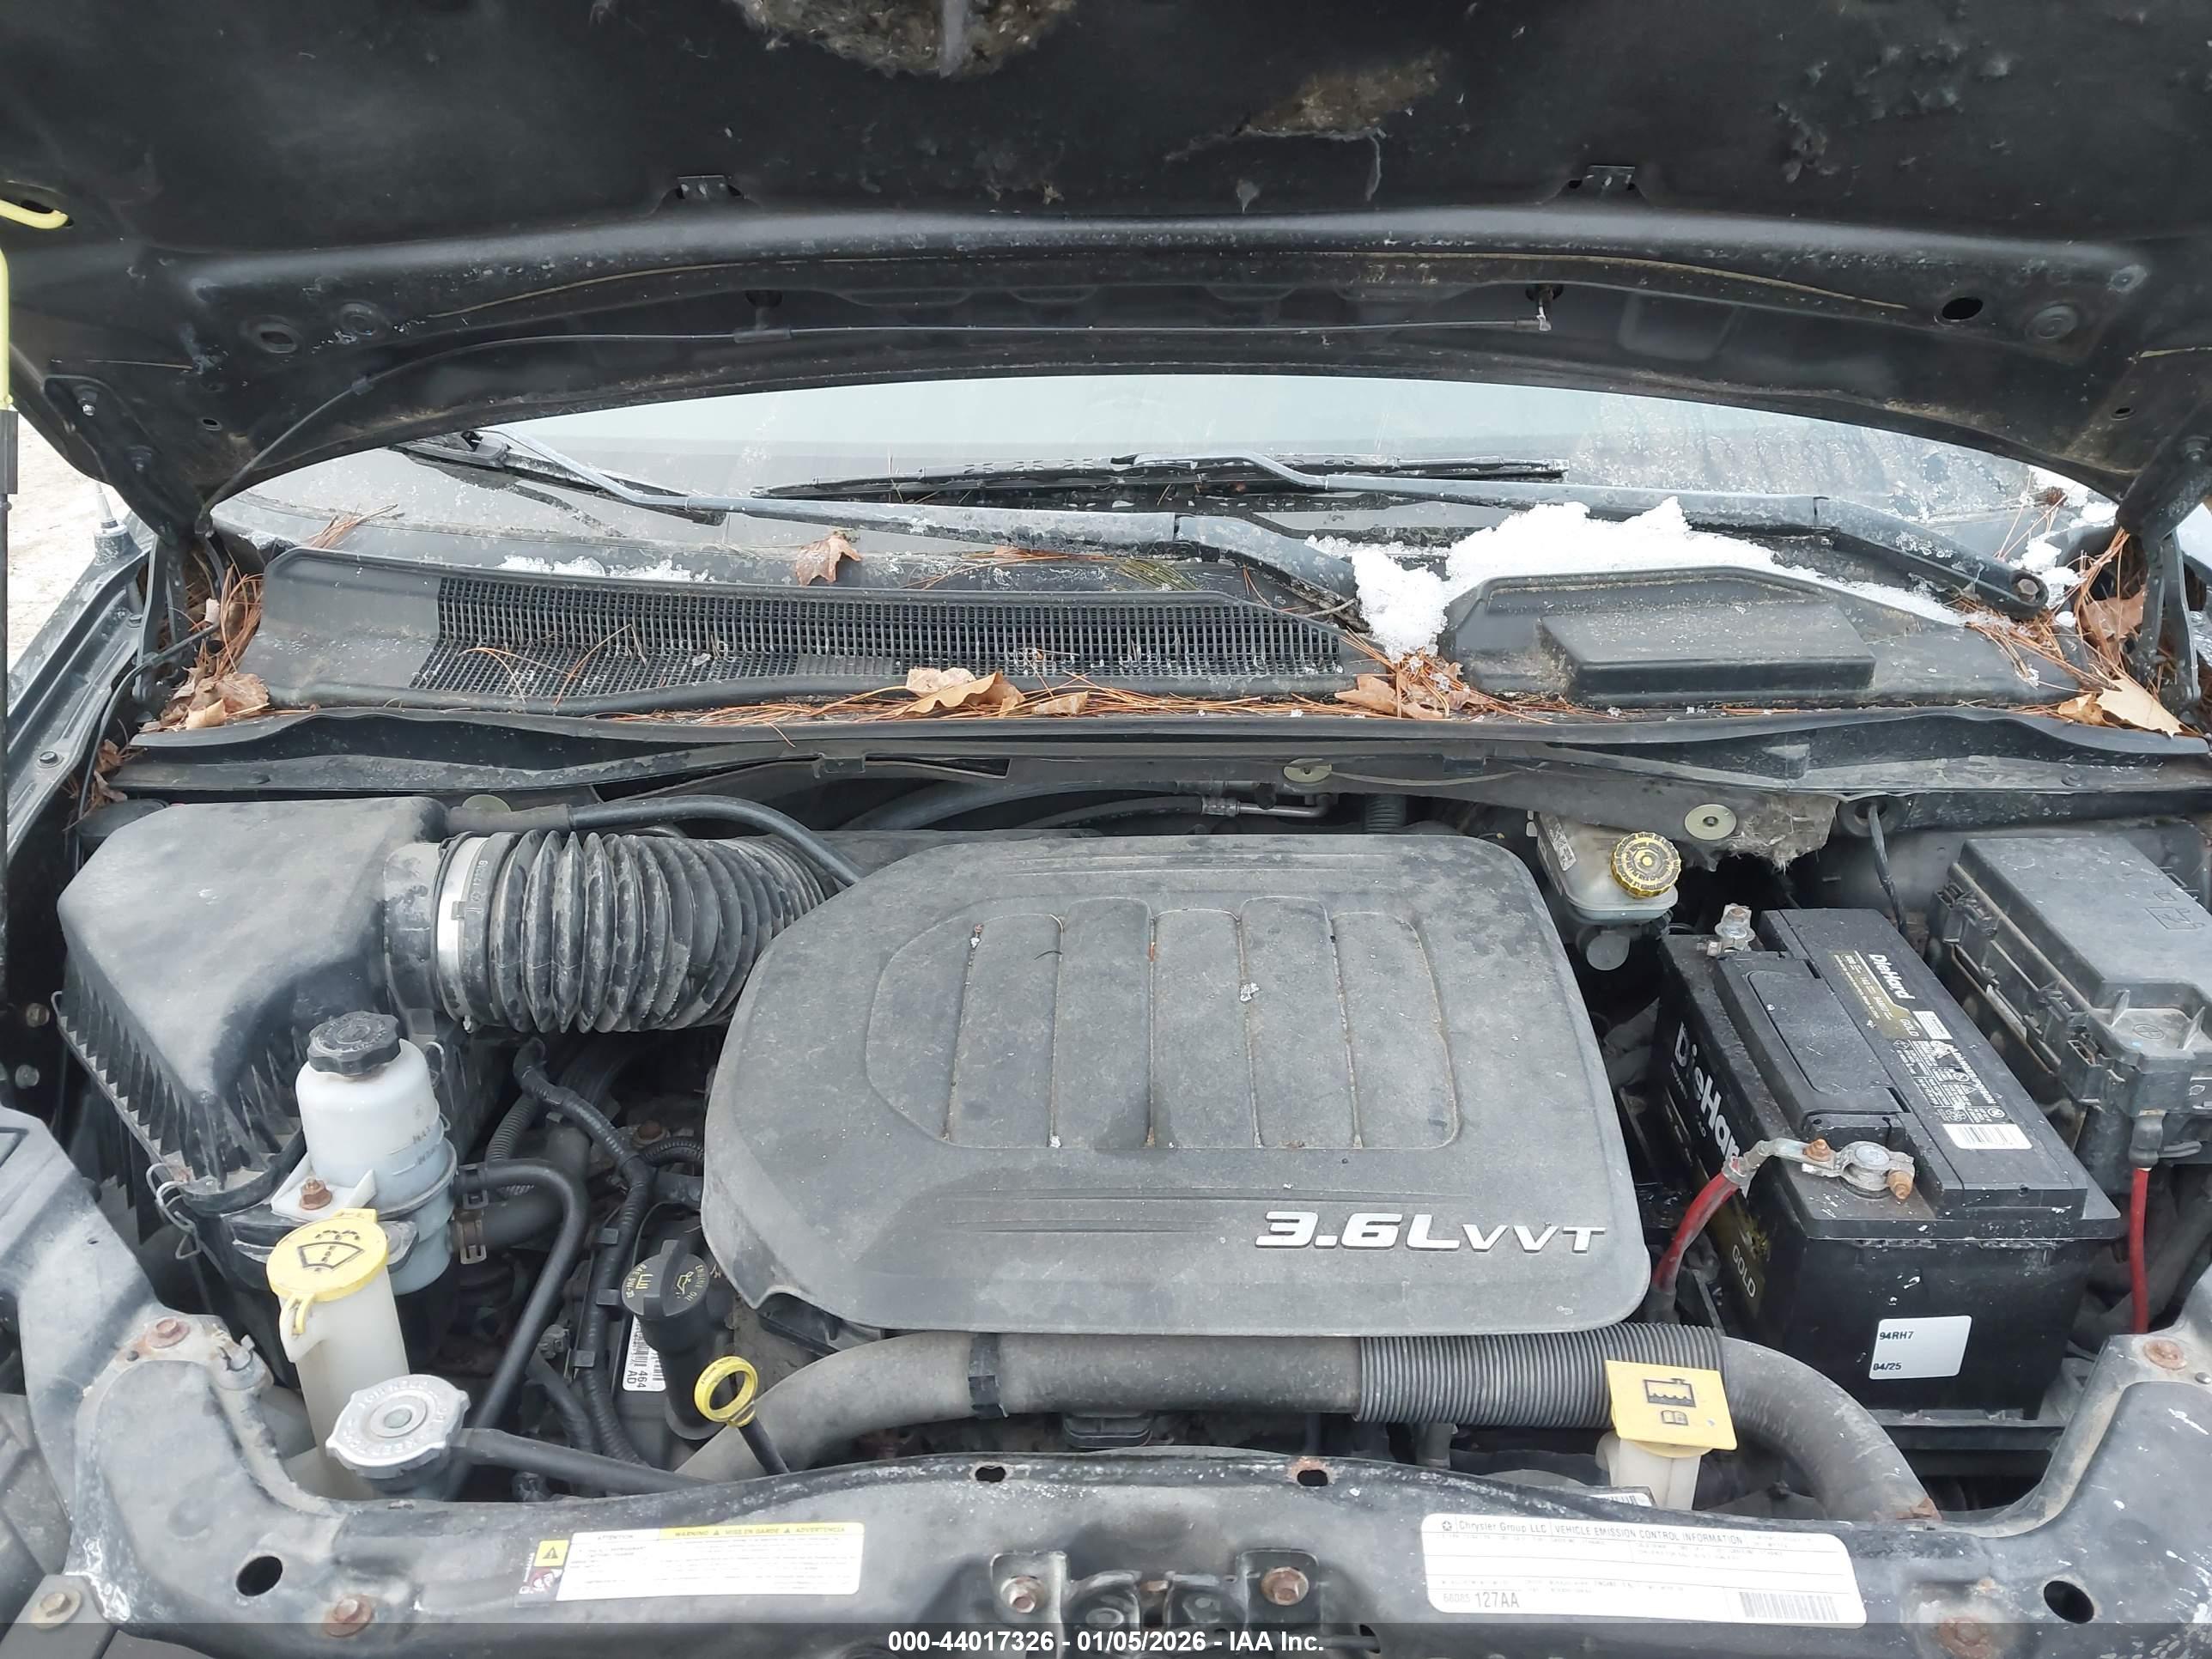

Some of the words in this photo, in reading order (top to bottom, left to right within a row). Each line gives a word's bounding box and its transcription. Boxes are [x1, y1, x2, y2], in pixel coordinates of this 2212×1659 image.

[1869, 953, 1916, 1000] DieHard
[1900, 1018, 1920, 1037] GOLD
[1731, 1244, 1757, 1298] GOLD
[1879, 1331, 1914, 1340] 94RH7
[1873, 1362, 1902, 1370] 04/25
[627, 1370, 638, 1384] AD
[636, 1370, 648, 1389] 464
[1459, 1520, 1496, 1533] Chrysler
[1499, 1522, 1527, 1533] Group
[1530, 1523, 1547, 1533] LLC
[1554, 1525, 1590, 1535] VEHICLE
[1594, 1527, 1636, 1538] EMISSION
[1638, 1529, 1680, 1540] CONTROL
[1682, 1531, 1743, 1544] INFORMATION
[1475, 1591, 1520, 1608] 127AA
